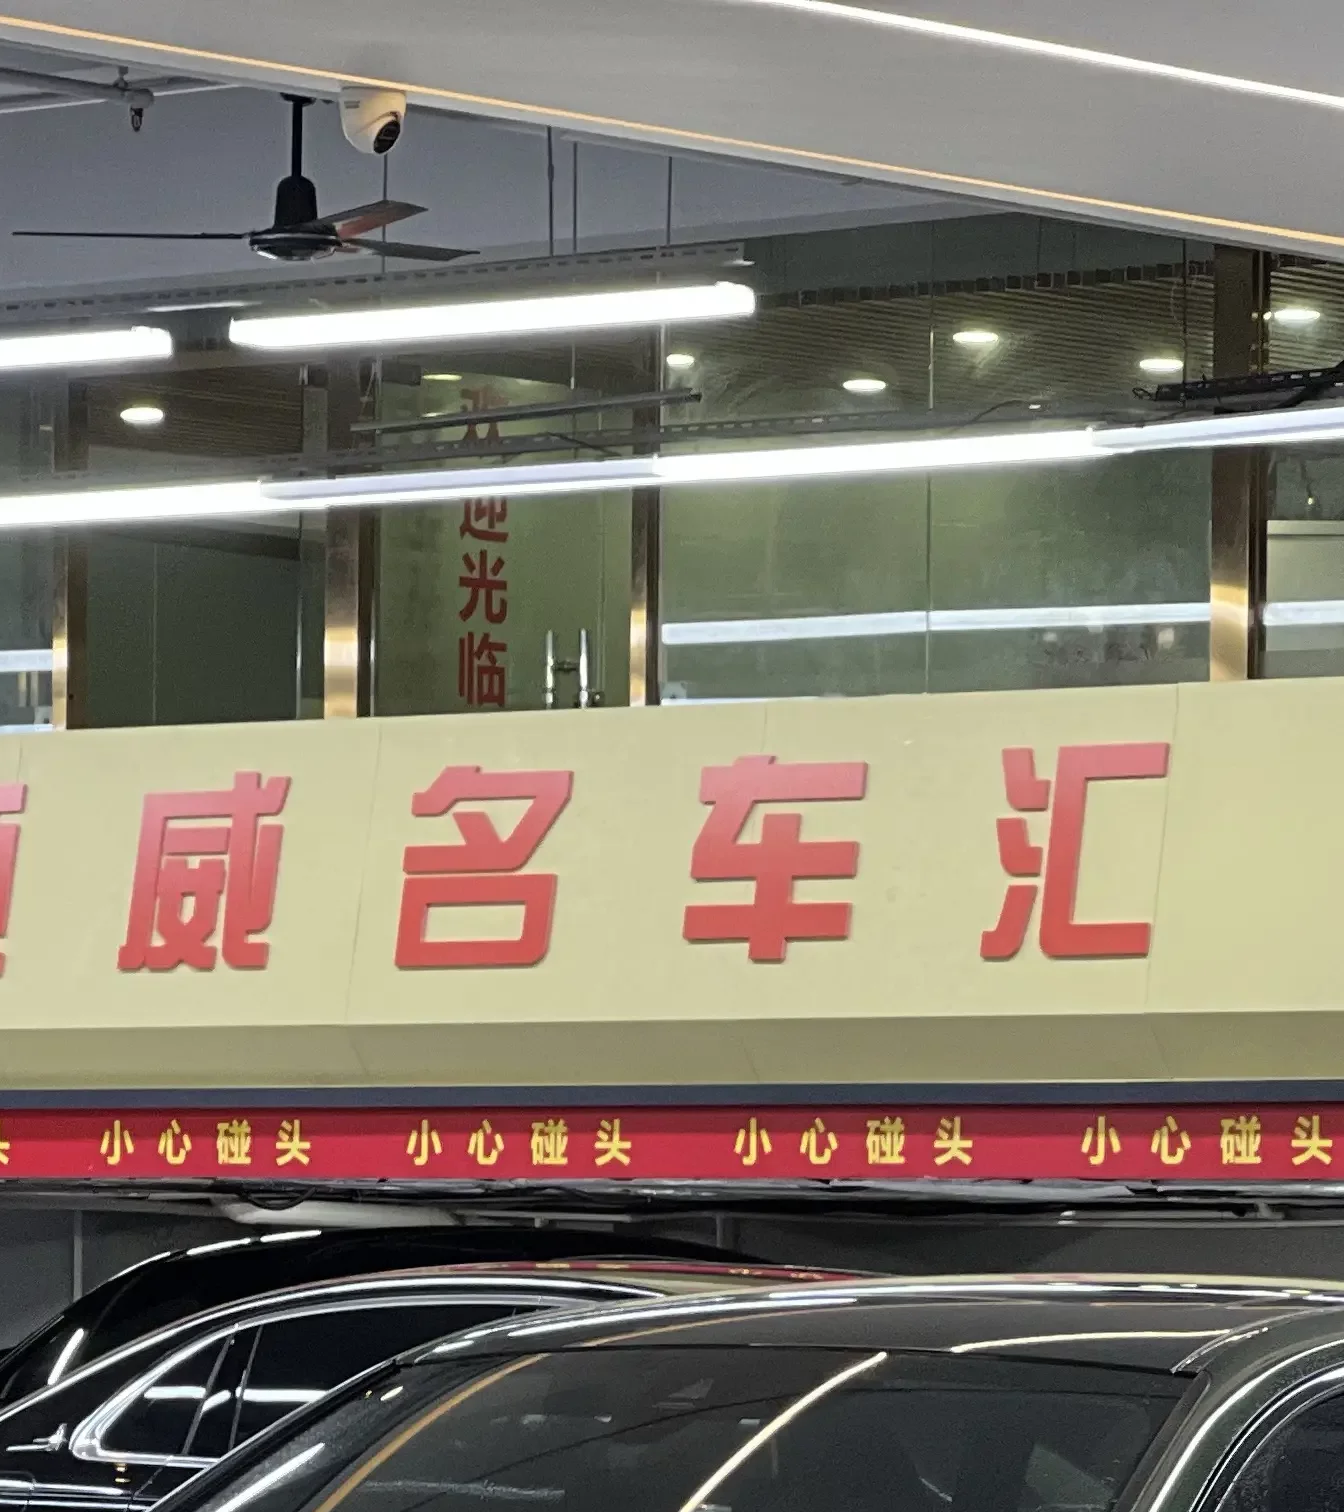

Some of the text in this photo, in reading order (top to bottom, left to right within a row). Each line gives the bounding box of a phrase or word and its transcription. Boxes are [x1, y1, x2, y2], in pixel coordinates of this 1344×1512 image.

[100, 1118, 312, 1167] 小心碰头
[406, 1118, 632, 1167] 小心碰头
[734, 1116, 974, 1167] 小心碰头
[1081, 1114, 1334, 1166] 小心碰头
